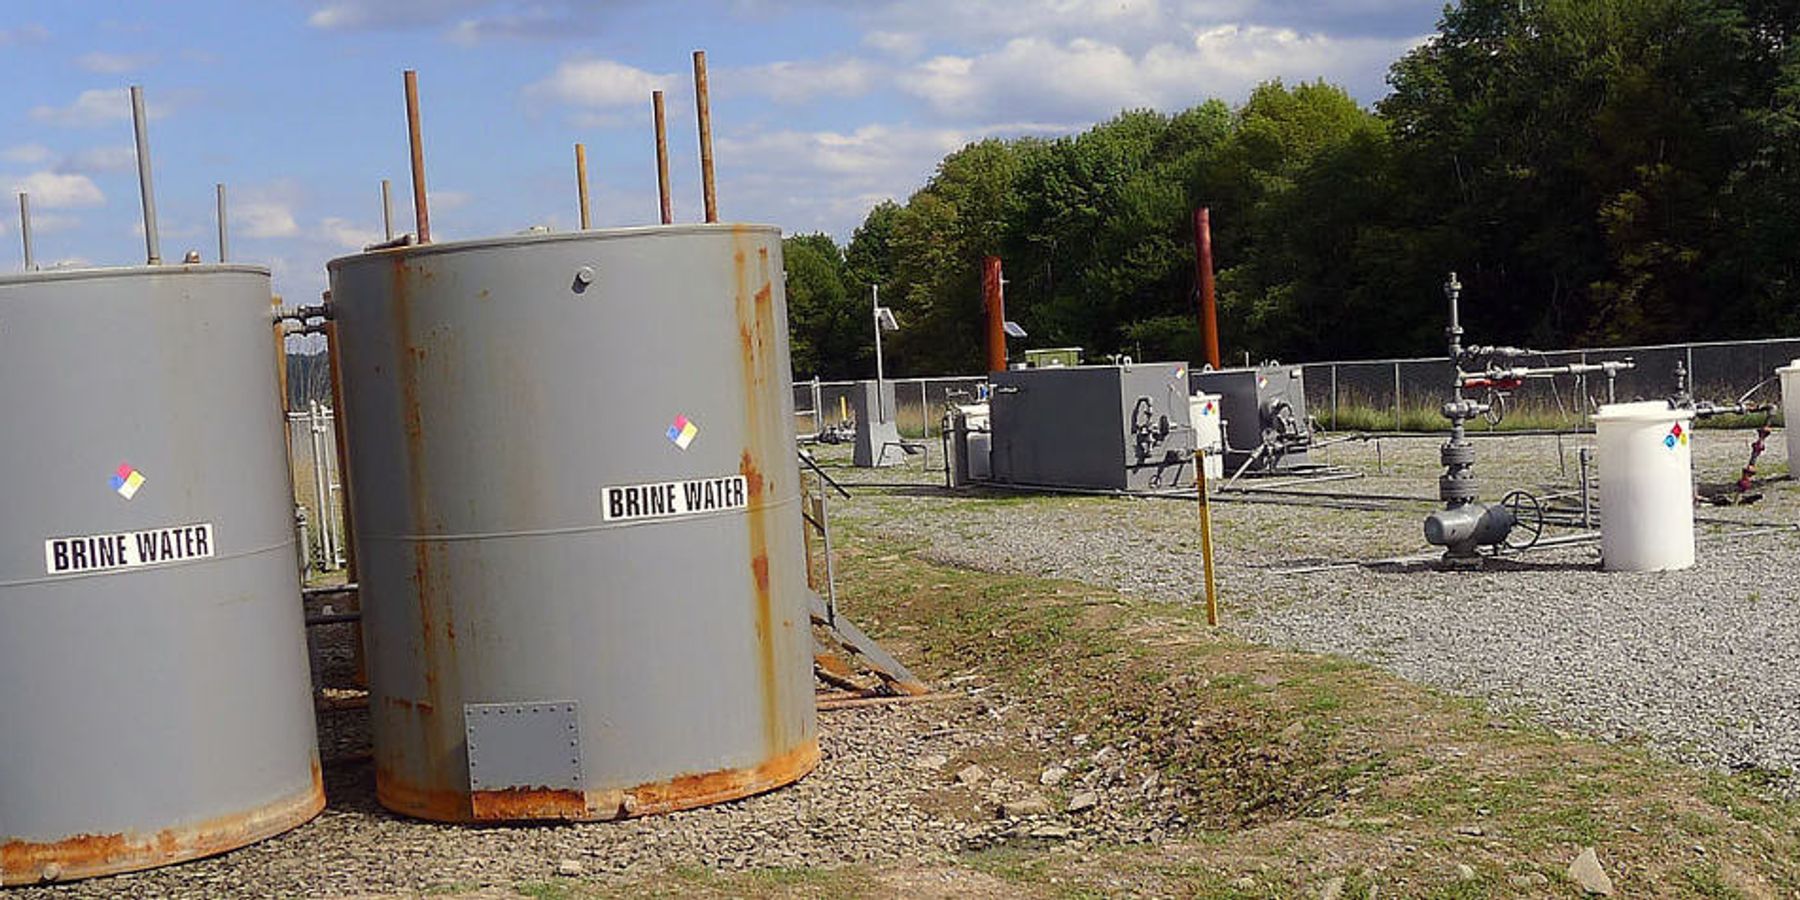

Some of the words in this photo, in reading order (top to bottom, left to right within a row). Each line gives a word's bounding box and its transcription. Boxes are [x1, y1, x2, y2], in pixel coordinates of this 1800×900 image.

[609, 485, 675, 518] BRINE
[683, 479, 744, 512] WATER
[53, 535, 128, 571] BRINE
[136, 526, 208, 563] WATER
